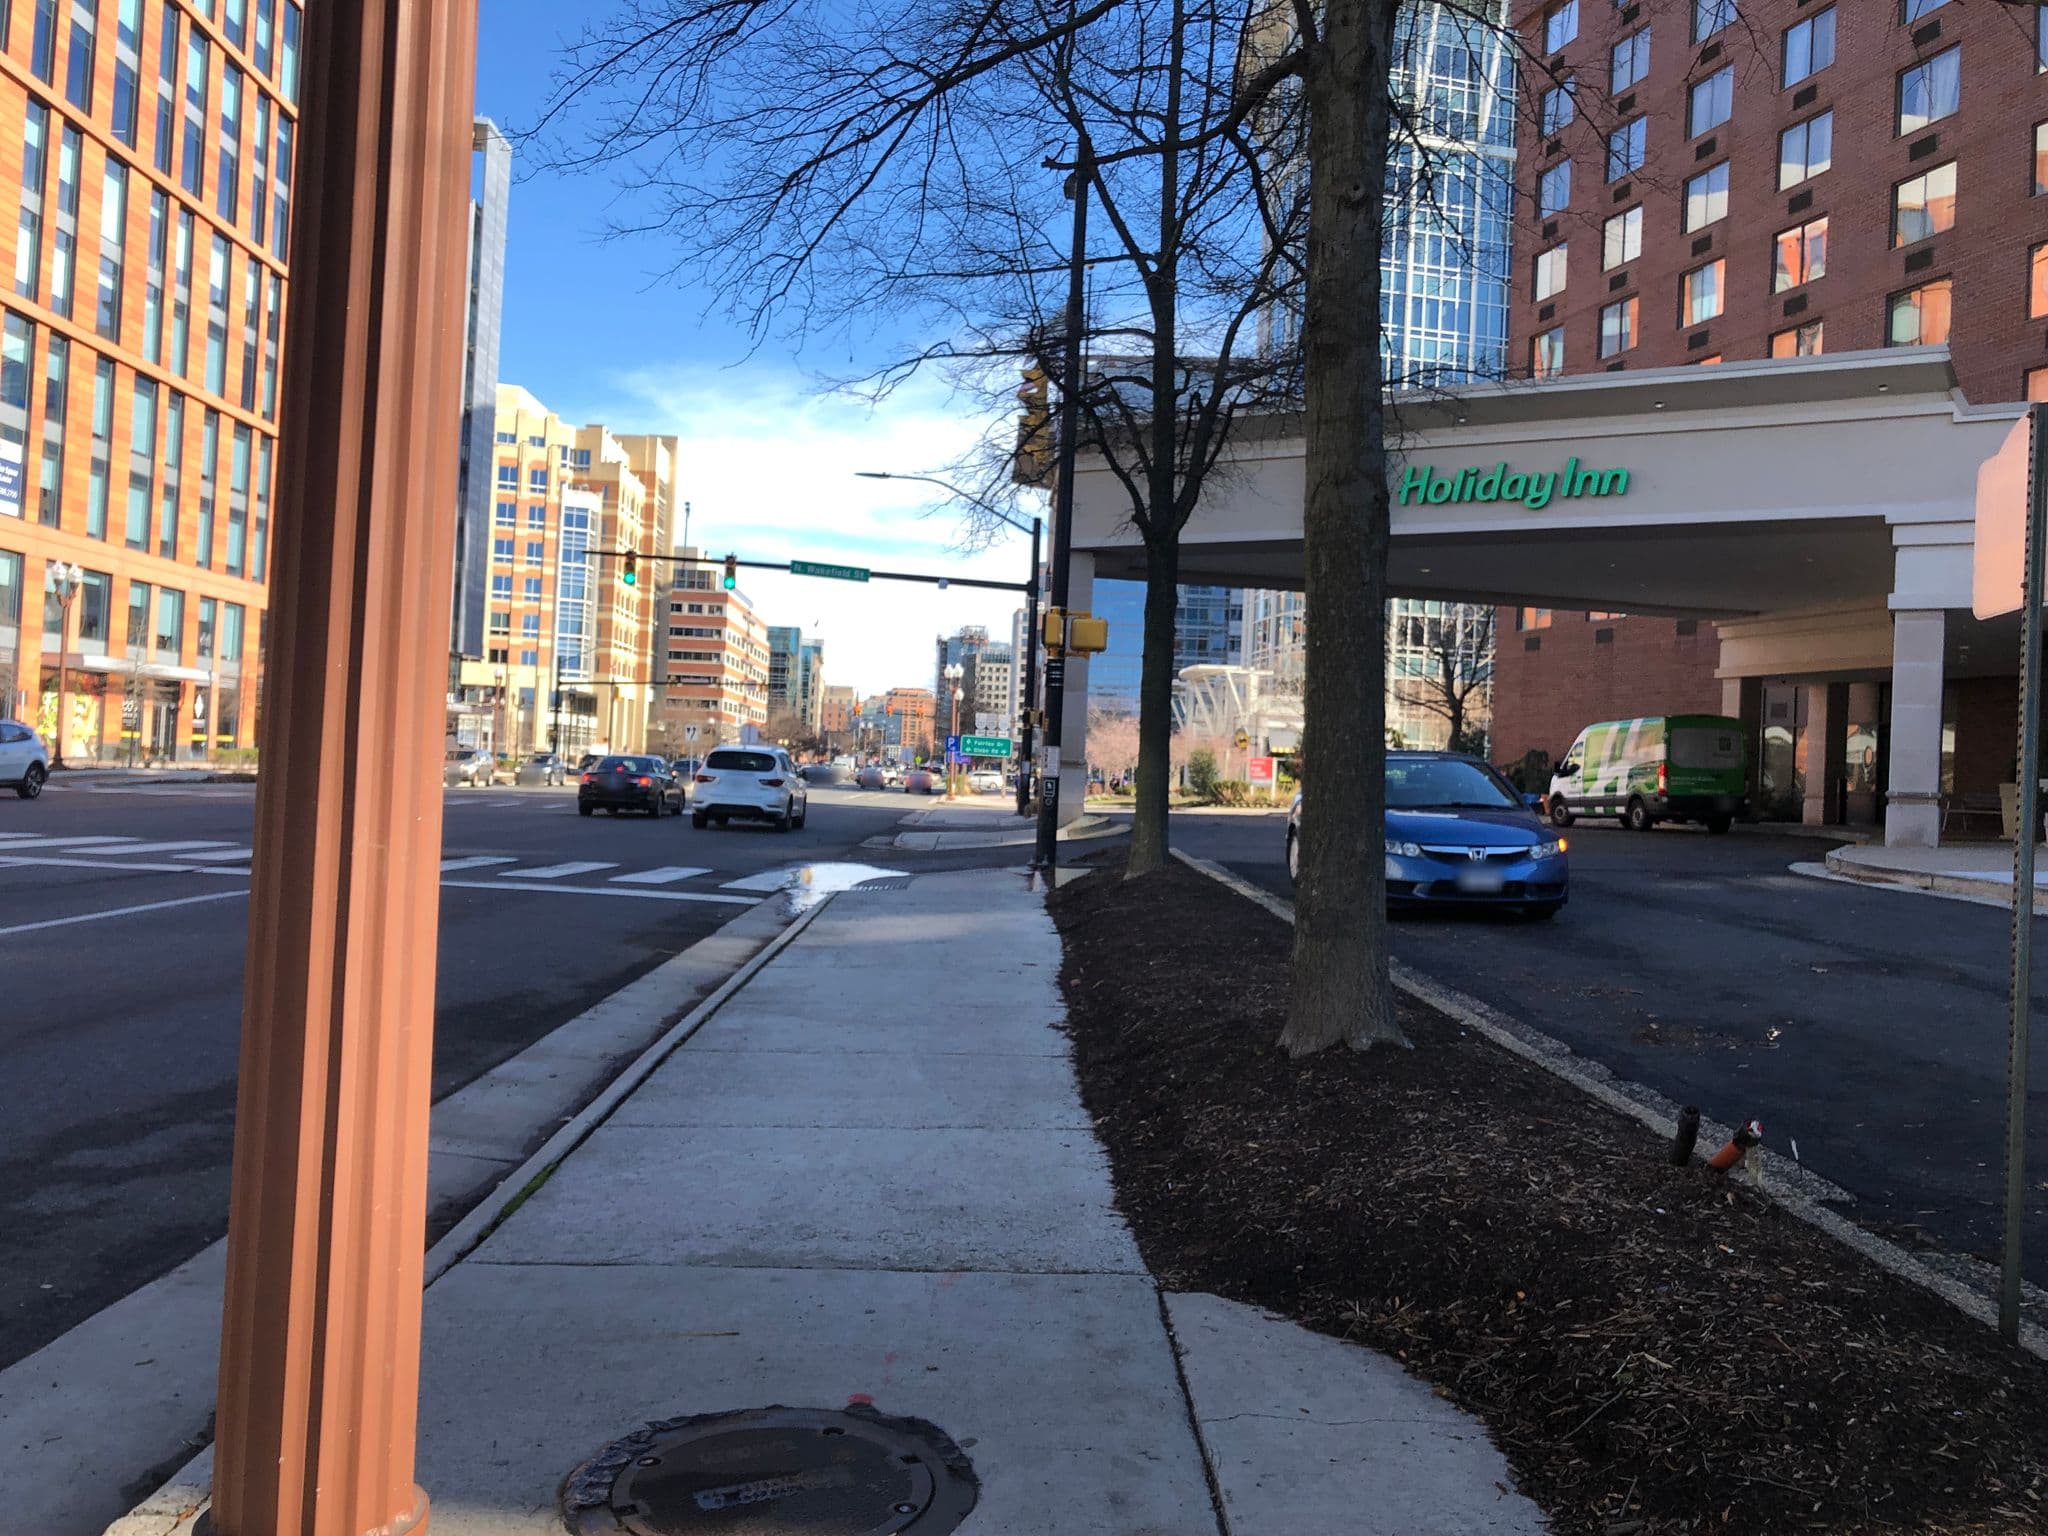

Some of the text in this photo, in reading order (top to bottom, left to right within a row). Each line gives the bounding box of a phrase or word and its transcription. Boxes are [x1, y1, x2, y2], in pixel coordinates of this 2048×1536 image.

[1398, 456, 1630, 509] Holiday Inn
[808, 565, 851, 577] Wakefield
